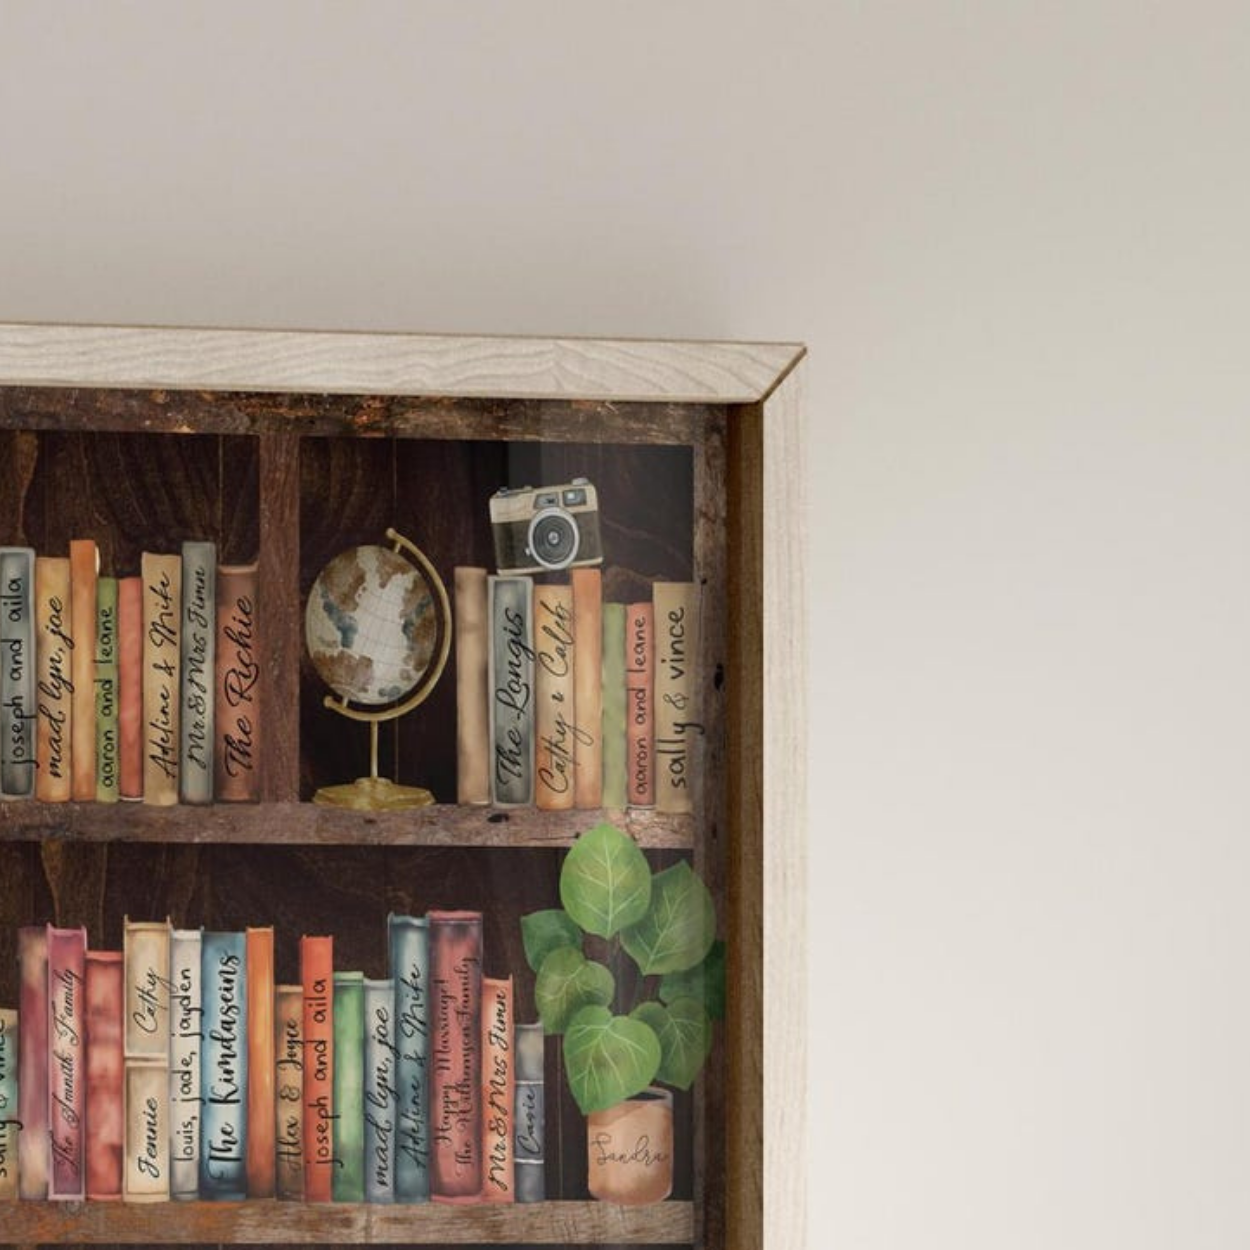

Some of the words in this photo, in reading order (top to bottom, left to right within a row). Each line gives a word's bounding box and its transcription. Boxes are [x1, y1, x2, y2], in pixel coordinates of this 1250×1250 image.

[0, 577, 22, 622] aila
[45, 595, 75, 650] joe
[149, 572, 177, 648] Mike
[0, 638, 23, 681] and
[93, 607, 113, 665] leane
[224, 595, 260, 707] Richie
[538, 600, 574, 677] Caleb
[627, 617, 646, 673] leane
[661, 607, 684, 680] vince
[94, 678, 113, 717] and
[153, 660, 176, 677] &
[627, 688, 646, 725] and
[663, 692, 690, 711] &
[2, 695, 40, 769] joseph
[102, 729, 113, 788] aaron
[149, 685, 177, 779] Adeline
[224, 716, 253, 777] The
[495, 728, 523, 785] The
[538, 714, 594, 793] Cathy
[655, 721, 705, 789] sally
[634, 737, 646, 795] aaron
[133, 967, 177, 1033] Cathy
[171, 968, 205, 1040] jayden
[304, 978, 326, 1022] aila
[277, 1019, 304, 1071] Joyce
[304, 1039, 326, 1080] and
[172, 1051, 206, 1105] jade,
[280, 1086, 299, 1101] &
[138, 1097, 159, 1178] Jennie
[173, 1115, 198, 1161] louis,
[276, 1116, 301, 1172] Alex
[307, 1096, 343, 1168] joseph
[433, 1085, 457, 1145] Happy
[209, 1122, 242, 1180] The
